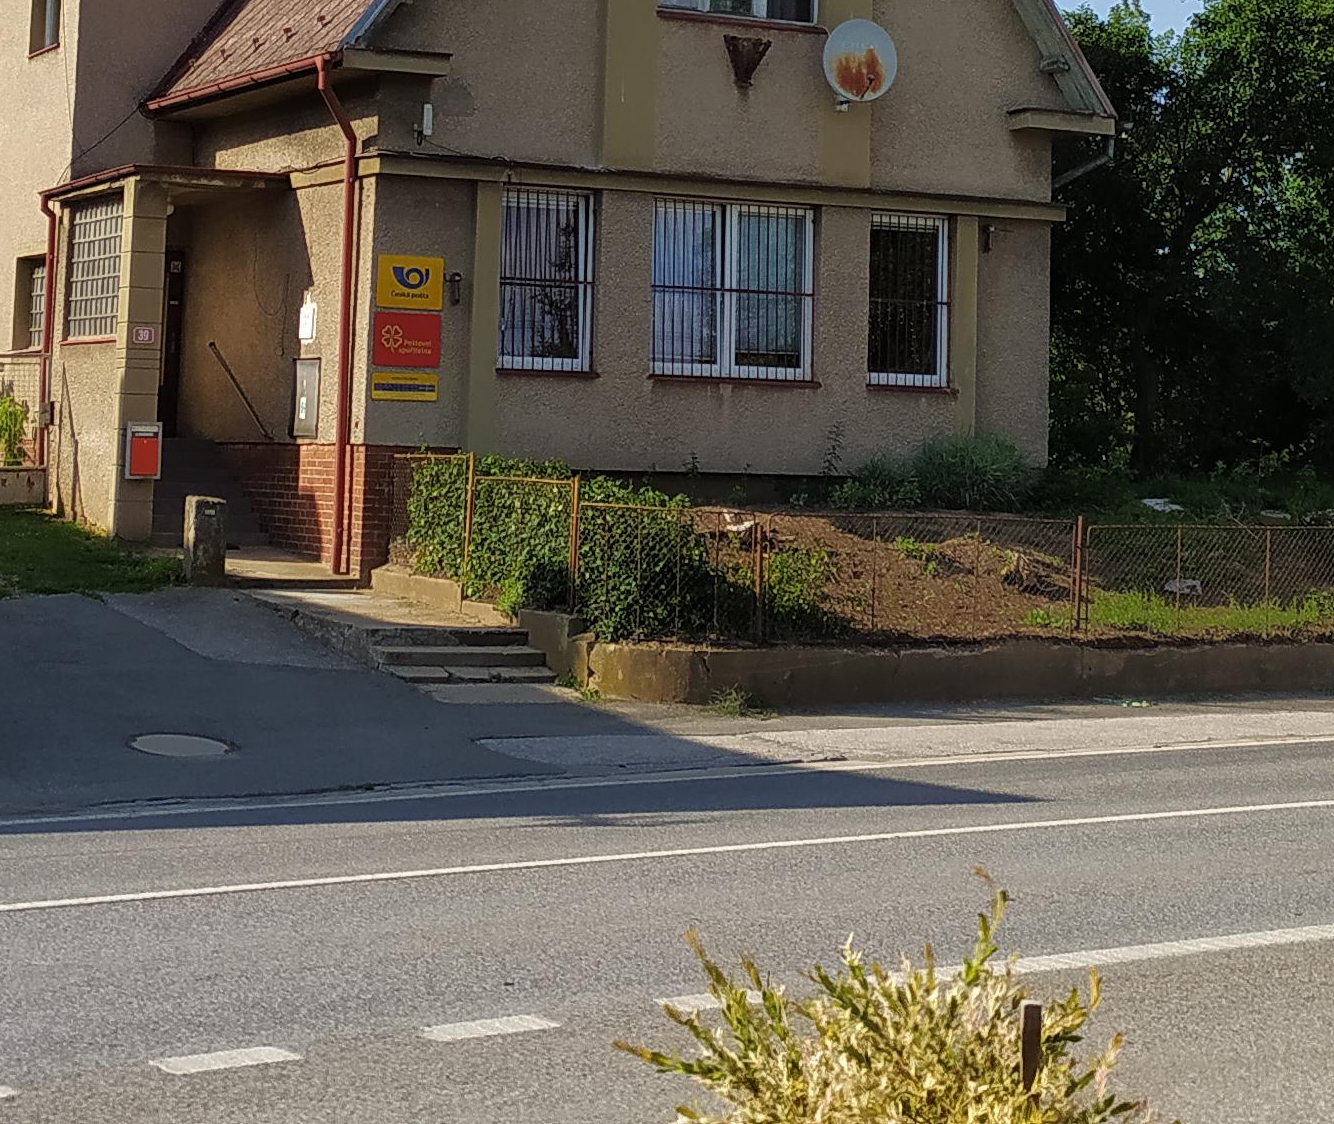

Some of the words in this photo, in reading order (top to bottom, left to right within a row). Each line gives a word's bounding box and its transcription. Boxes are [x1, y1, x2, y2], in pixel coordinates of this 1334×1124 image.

[390, 290, 410, 298] Česká
[411, 291, 429, 299] pošta
[137, 329, 150, 341] 39
